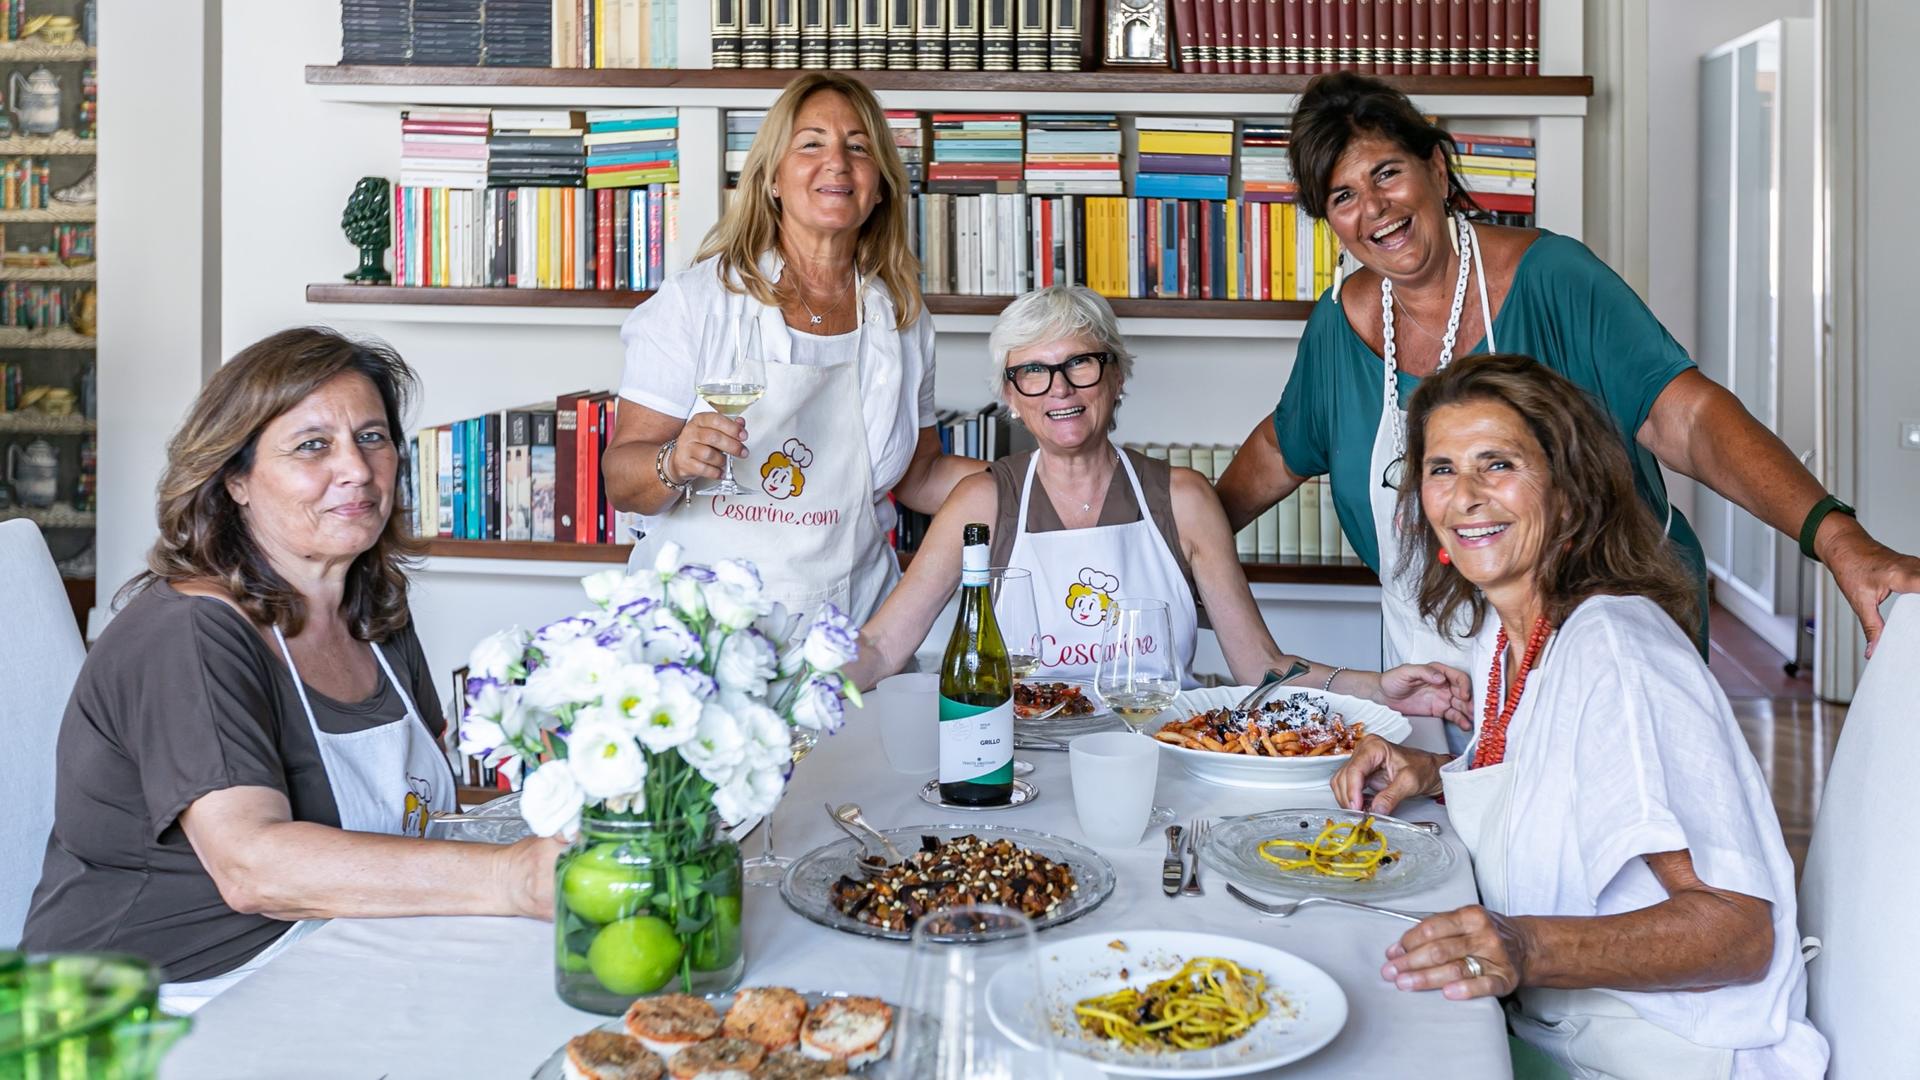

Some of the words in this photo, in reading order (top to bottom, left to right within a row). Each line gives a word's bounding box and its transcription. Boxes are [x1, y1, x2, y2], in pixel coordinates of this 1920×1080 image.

[711, 495, 840, 526] Cesarine.com
[1031, 634, 1157, 667] Cesarine
[980, 738, 1001, 746] GRILLO
